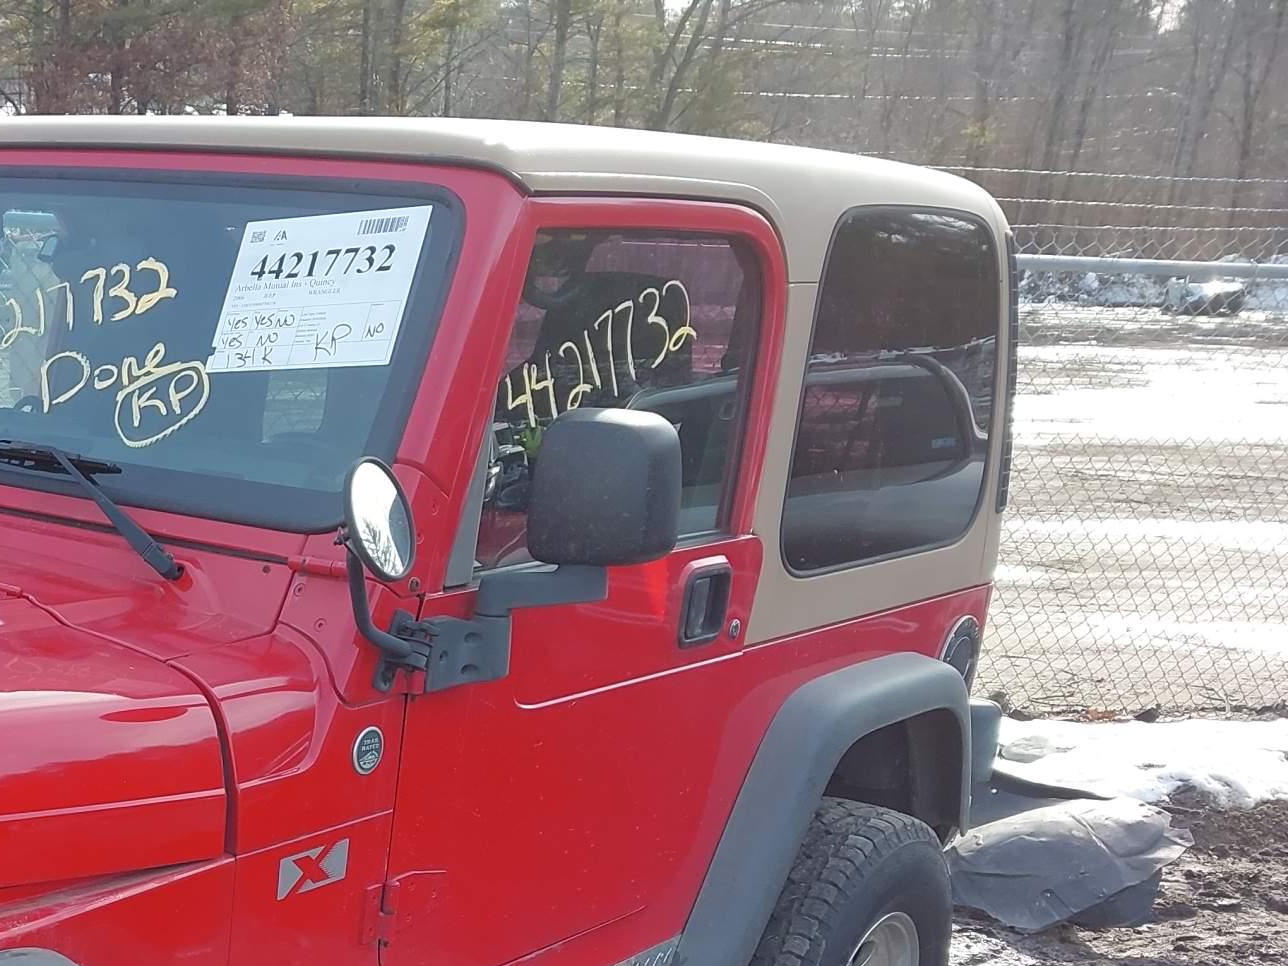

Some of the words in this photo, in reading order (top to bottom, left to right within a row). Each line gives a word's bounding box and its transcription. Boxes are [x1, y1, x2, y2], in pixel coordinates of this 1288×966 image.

[250, 244, 396, 281] 44217732
[364, 322, 385, 339] NO
[505, 279, 698, 428] 44217732
[132, 370, 200, 428] KP
